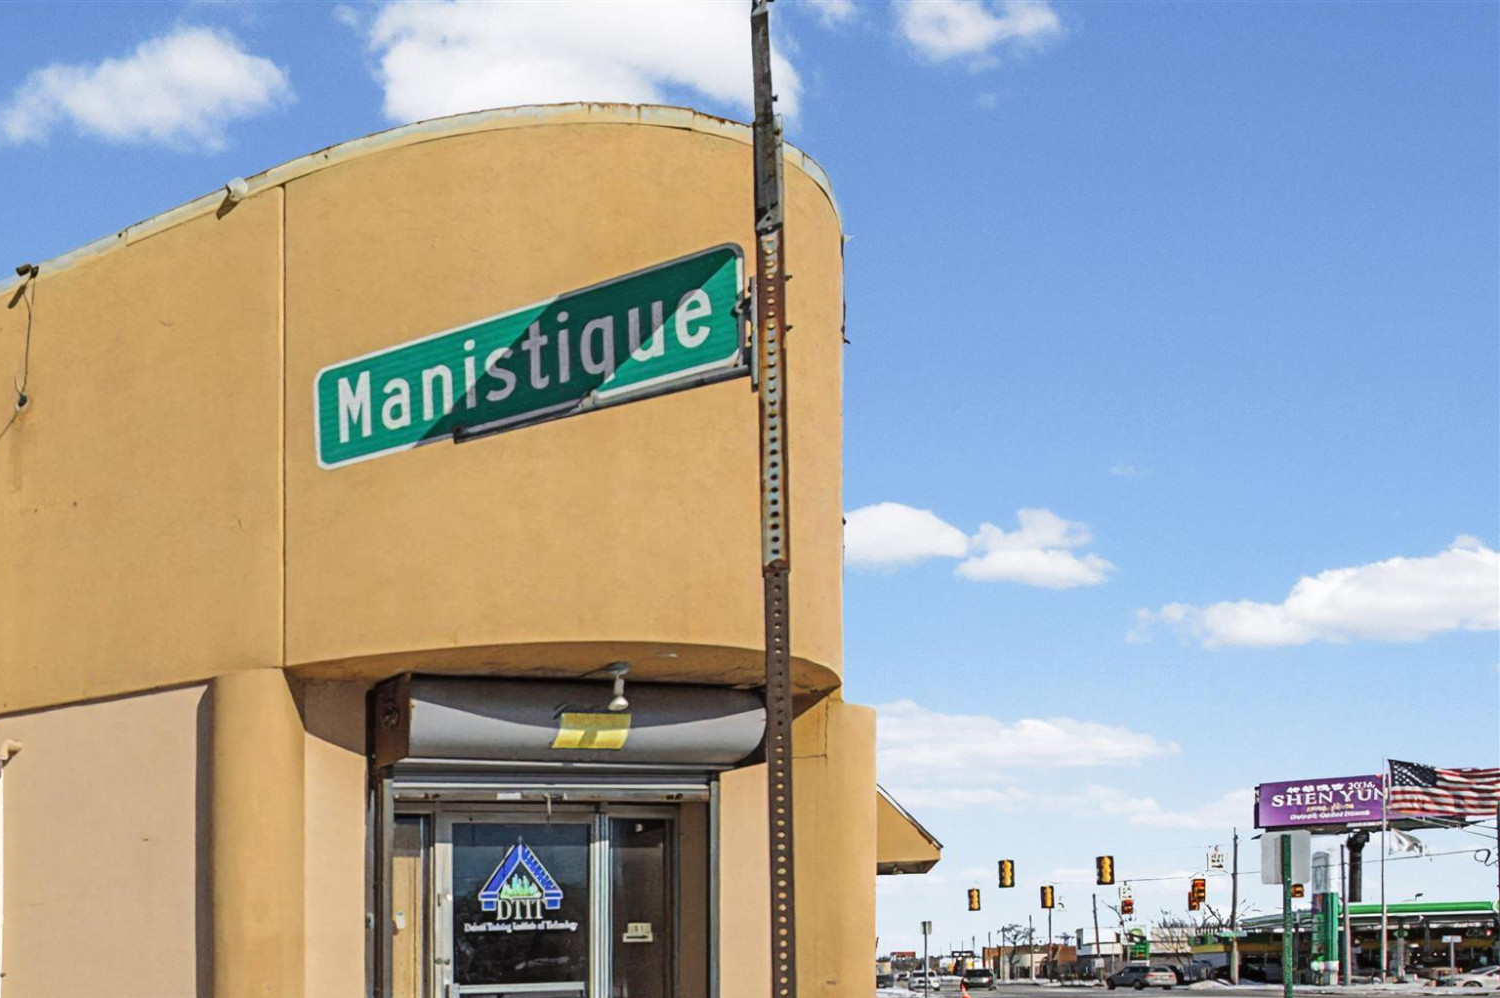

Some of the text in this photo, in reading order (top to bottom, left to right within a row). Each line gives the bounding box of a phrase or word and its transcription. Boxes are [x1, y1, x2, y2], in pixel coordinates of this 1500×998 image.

[338, 288, 712, 444] Manistique
[1271, 791, 1333, 807] SHEN
[1339, 787, 1388, 802] YUN
